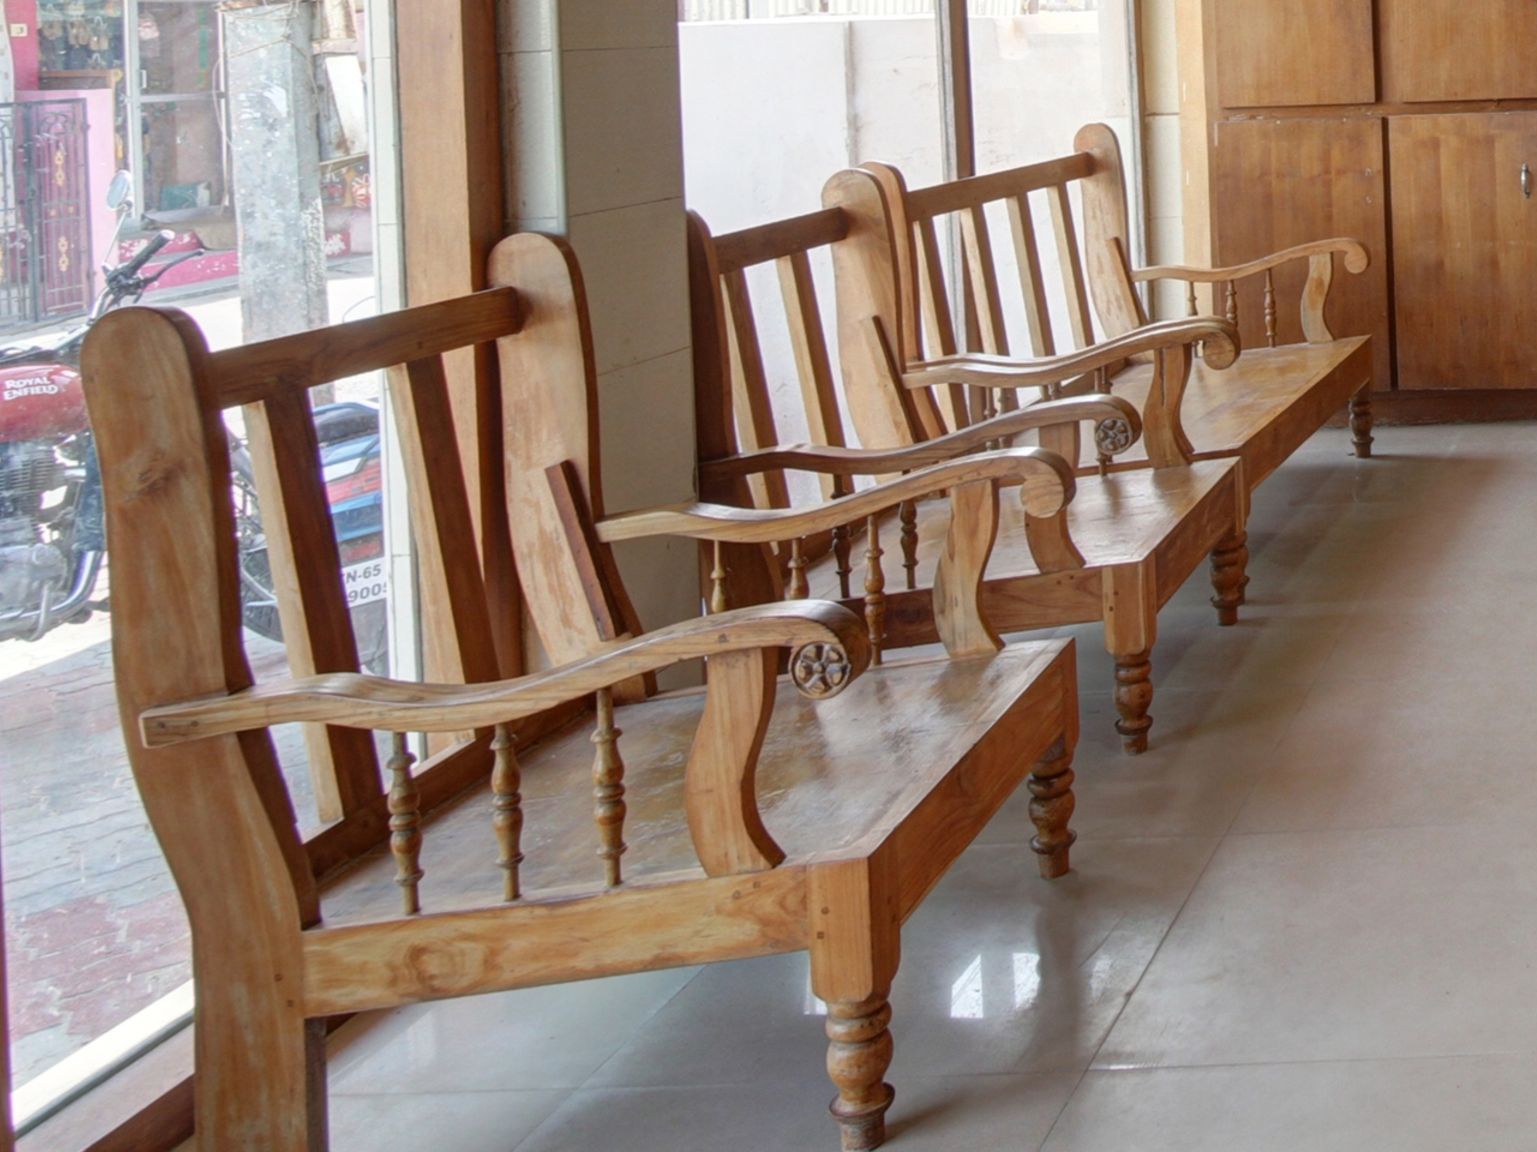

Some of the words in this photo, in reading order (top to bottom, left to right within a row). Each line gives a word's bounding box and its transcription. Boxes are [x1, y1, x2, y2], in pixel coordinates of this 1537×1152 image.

[4, 377, 51, 389] ROYAL
[3, 384, 59, 401] ENFIELD
[343, 563, 382, 585] N-65
